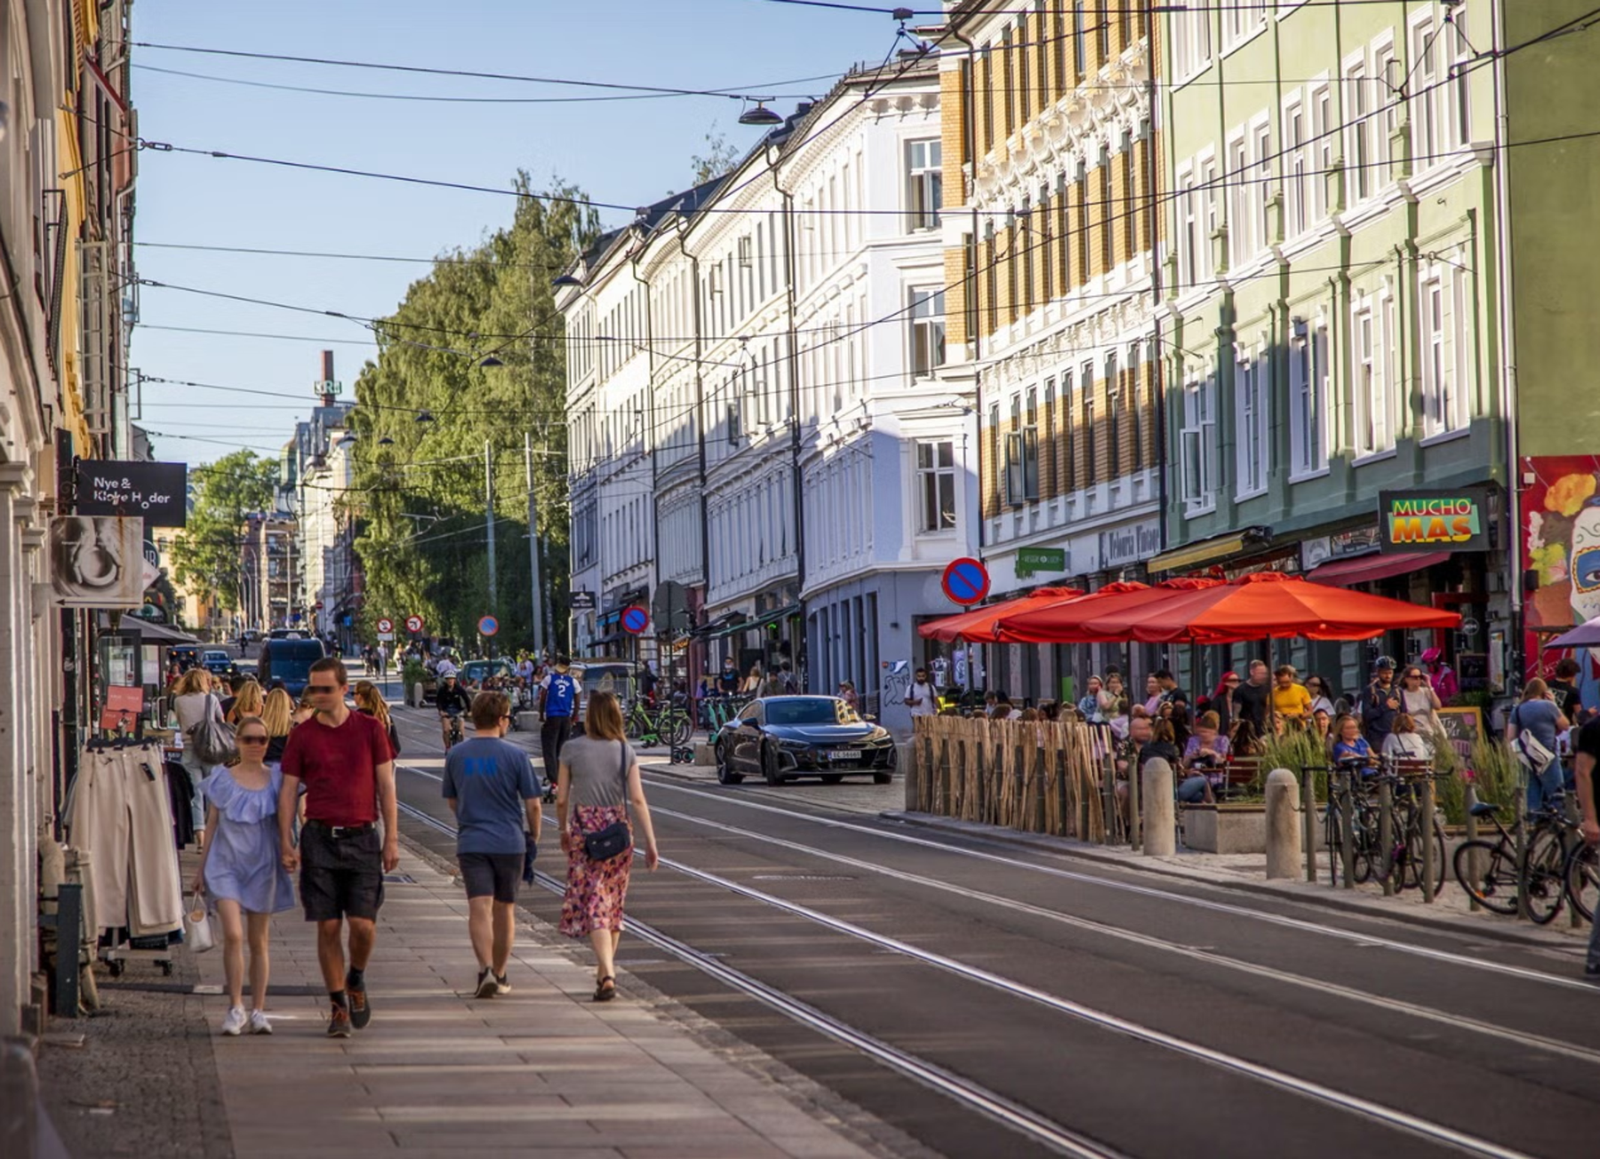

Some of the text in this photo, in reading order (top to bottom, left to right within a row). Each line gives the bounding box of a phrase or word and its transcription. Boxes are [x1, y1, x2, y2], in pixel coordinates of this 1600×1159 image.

[94, 477, 131, 490] Nye &
[1393, 498, 1471, 517] MUCHO
[1392, 517, 1473, 544] MAS
[557, 684, 566, 698] 2
